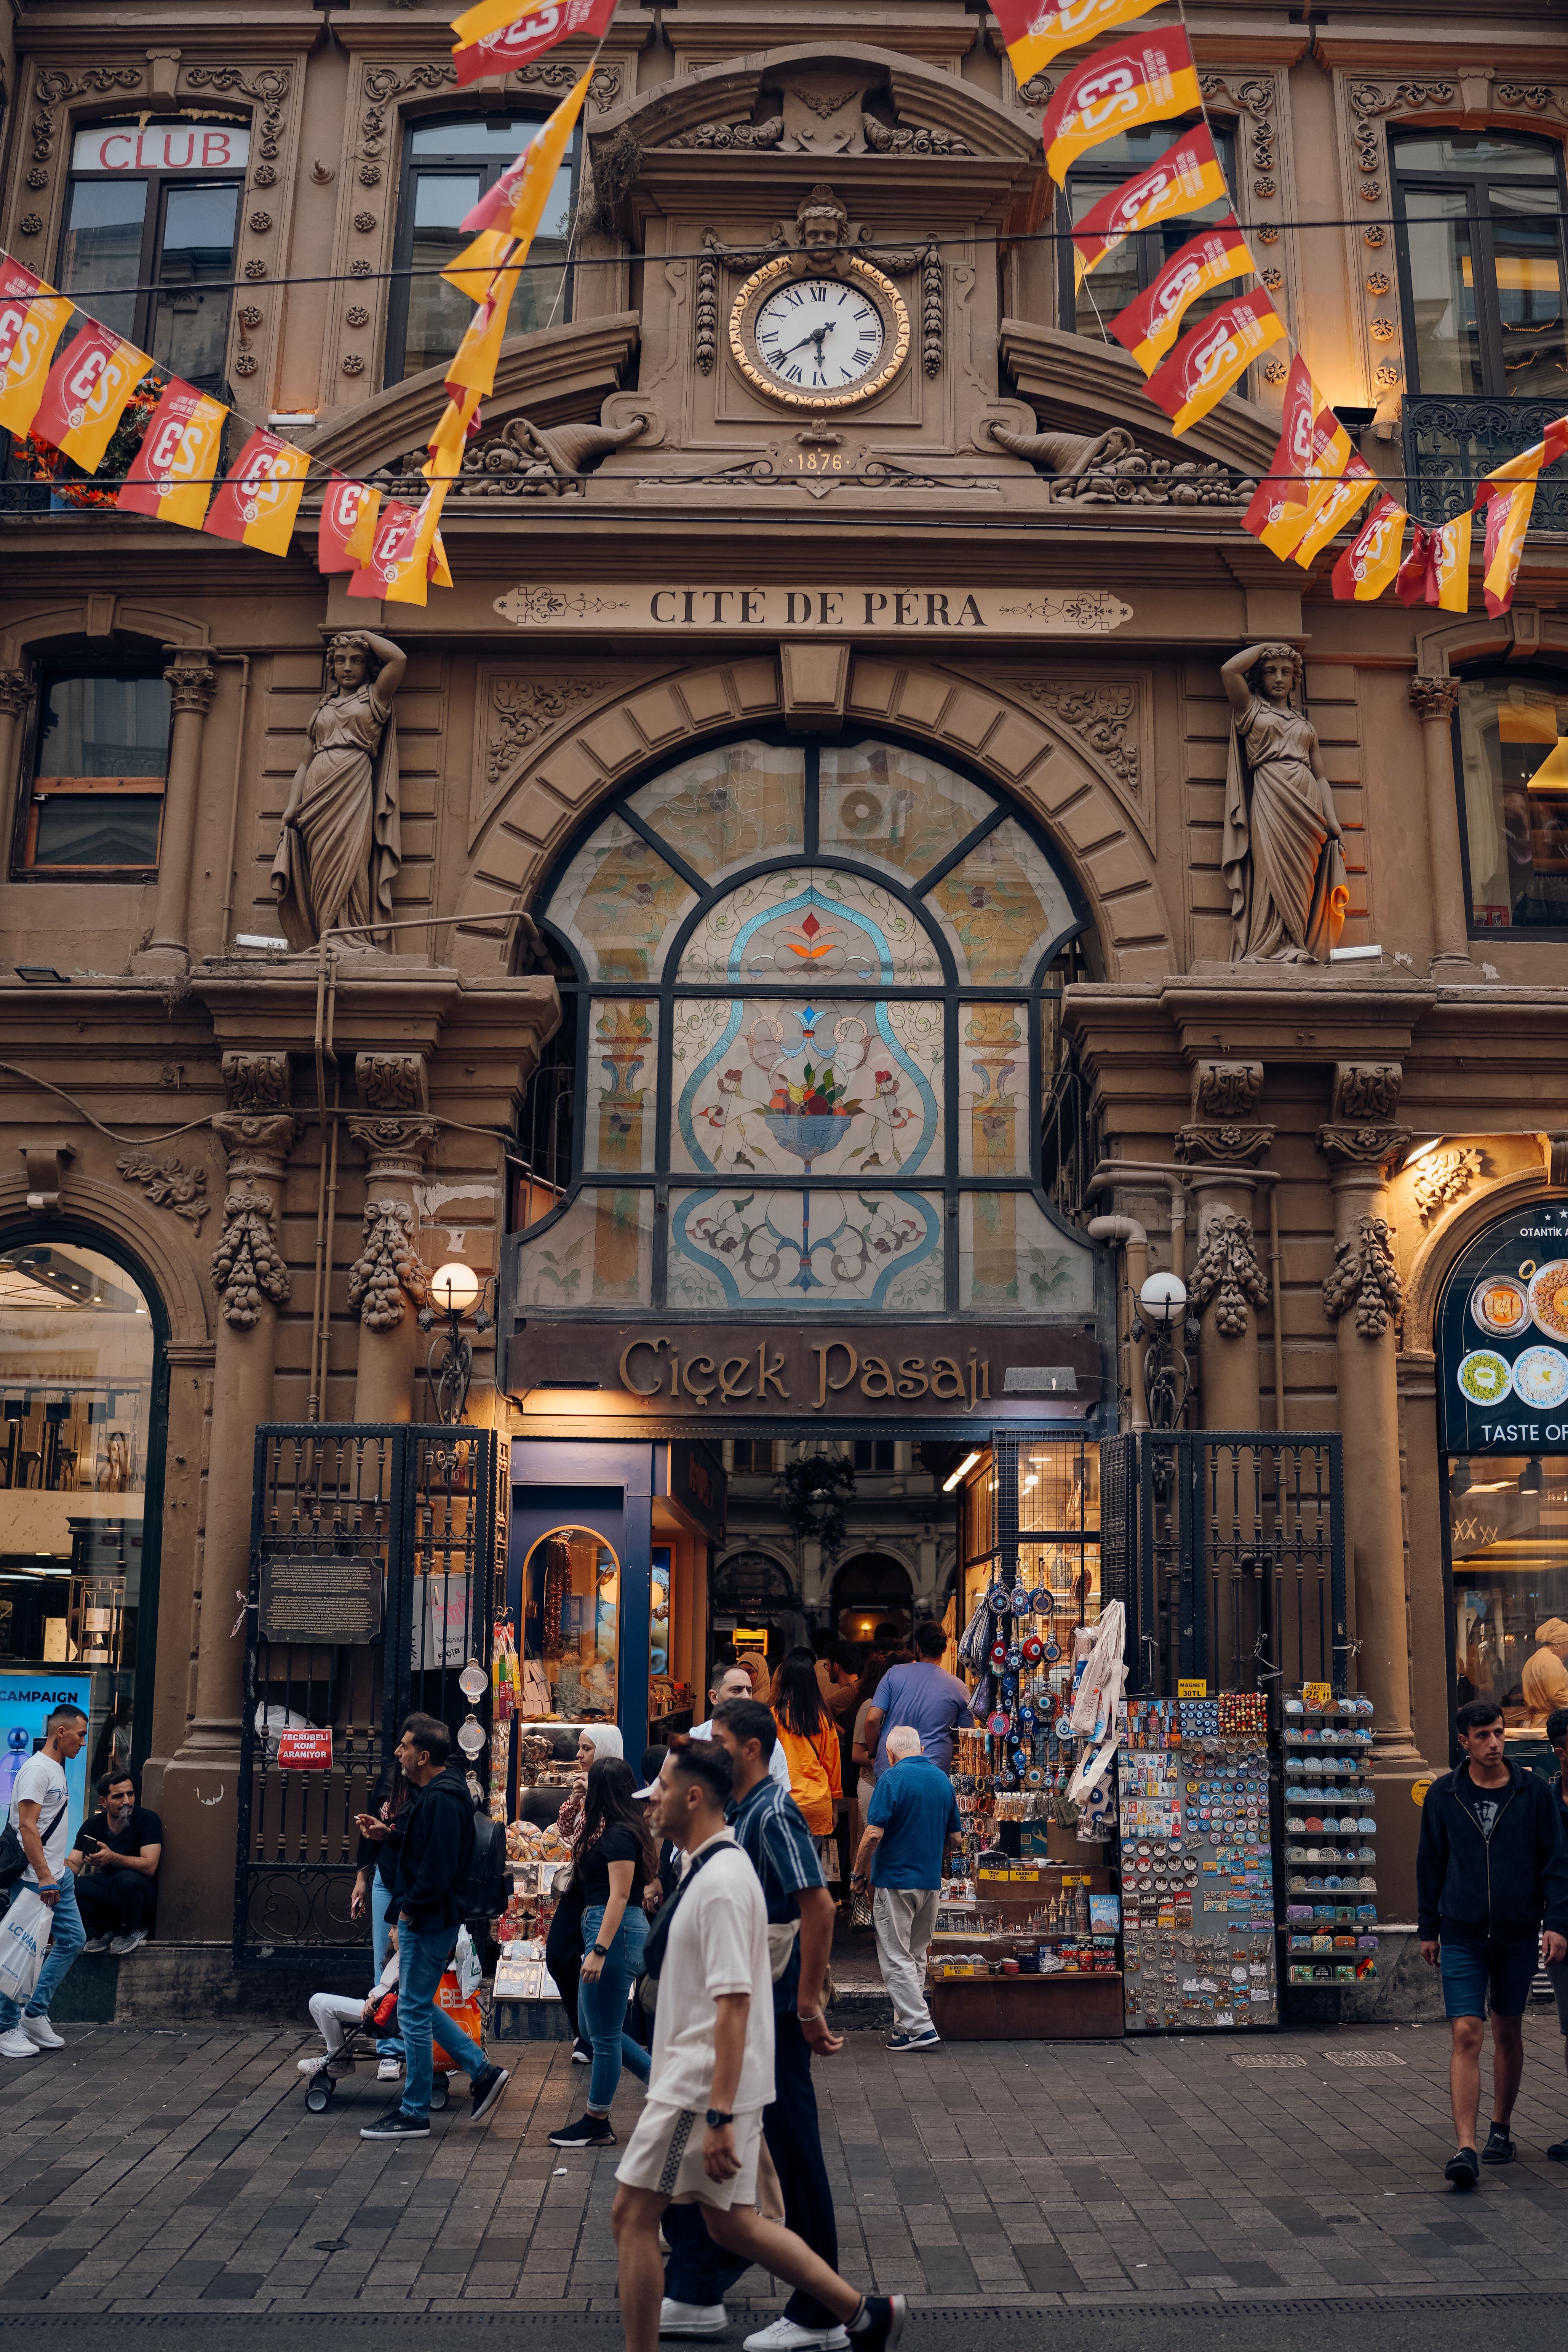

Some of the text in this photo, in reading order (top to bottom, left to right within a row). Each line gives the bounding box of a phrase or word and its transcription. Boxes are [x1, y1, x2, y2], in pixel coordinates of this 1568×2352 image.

[100, 133, 231, 170] CLUB
[798, 453, 842, 471] 1876
[651, 587, 988, 627] CITÉ DE PÉRA
[1520, 1226, 1562, 1237] OTANTİK
[812, 1341, 991, 1413] Pasajı
[1481, 1425, 1539, 1442] TASTE
[0, 1690, 78, 1703] CAMPAIGN
[1306, 1691, 1319, 1700] 25
[282, 1732, 328, 1741] TECRÜBELİ
[294, 1741, 316, 1749] KOMİ
